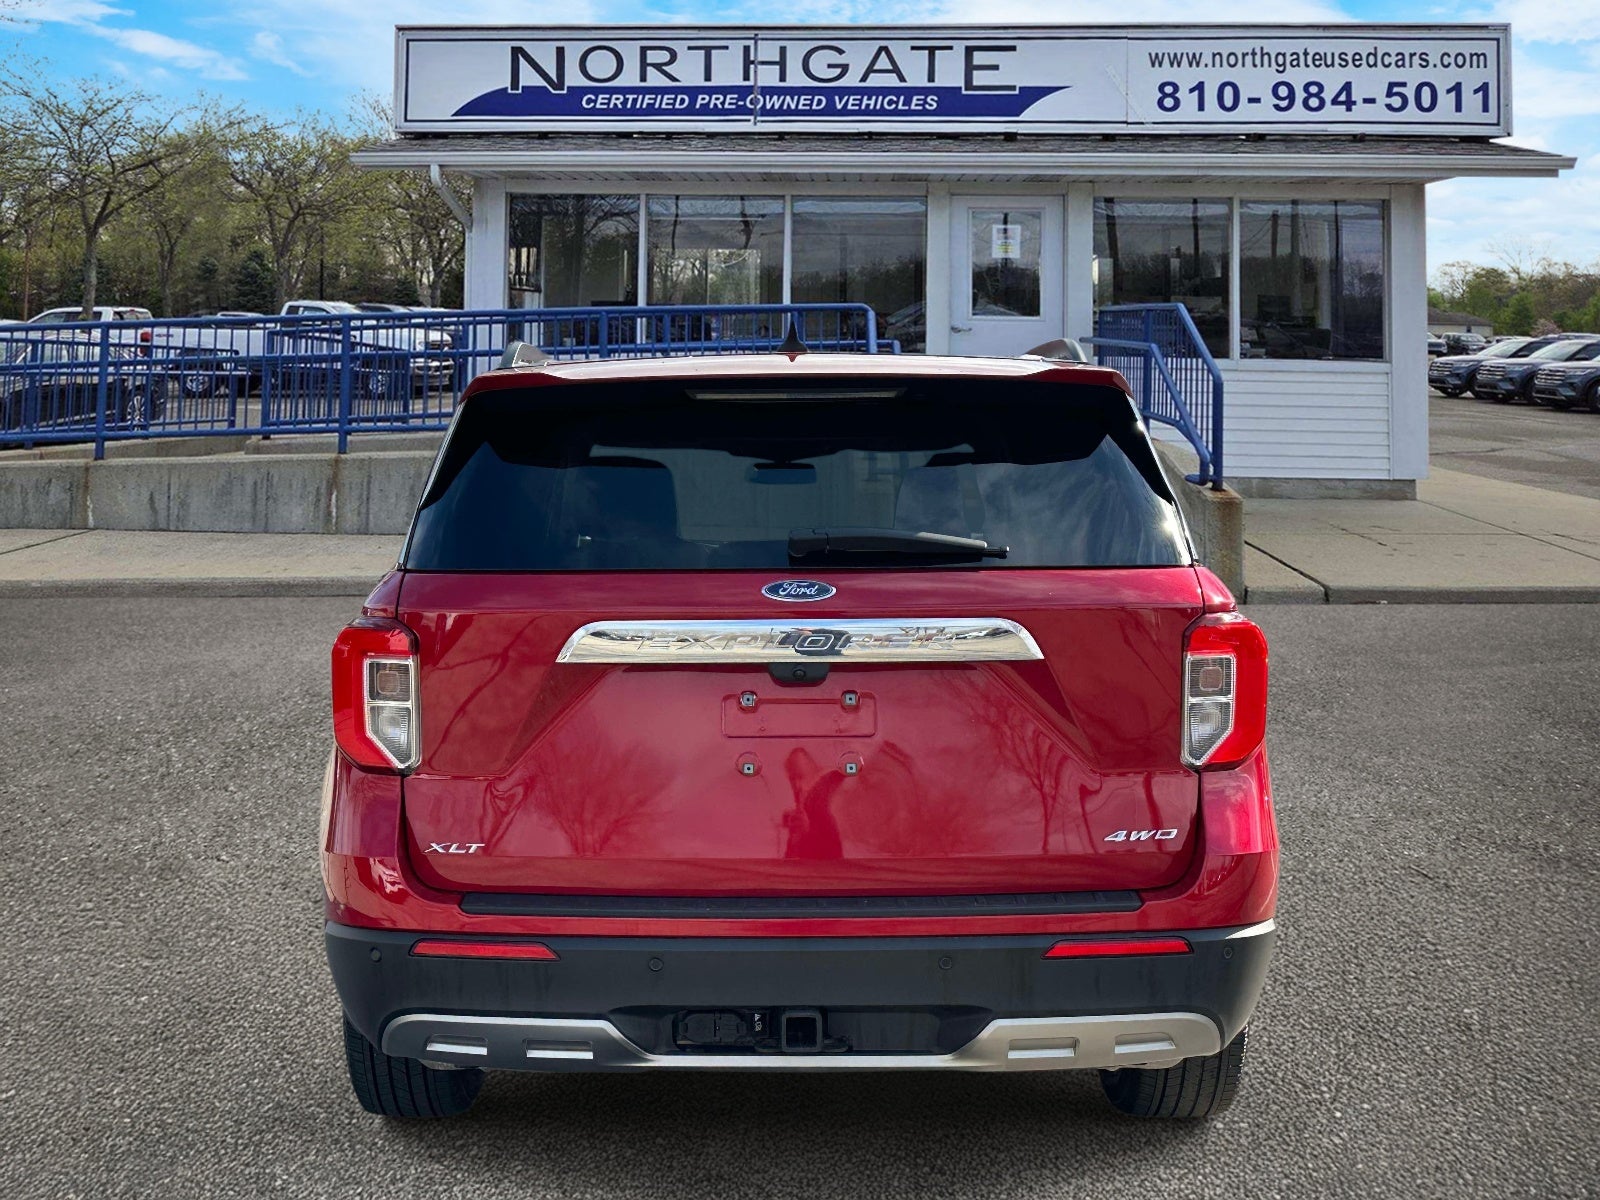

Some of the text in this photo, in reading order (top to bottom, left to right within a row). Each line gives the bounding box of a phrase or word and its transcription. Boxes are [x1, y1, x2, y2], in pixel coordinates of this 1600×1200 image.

[510, 45, 1017, 92] NORTHGATE
[1149, 47, 1488, 73] www.northgateusedcars.com
[581, 94, 938, 110] CERTIFIED PRE-OWNED VEHICLES
[1156, 80, 1491, 113] 810-984-5011
[779, 582, 819, 596] Ford
[637, 633, 957, 651] EXPLORER
[1104, 828, 1178, 842] 4WD
[424, 842, 486, 854] XLT
